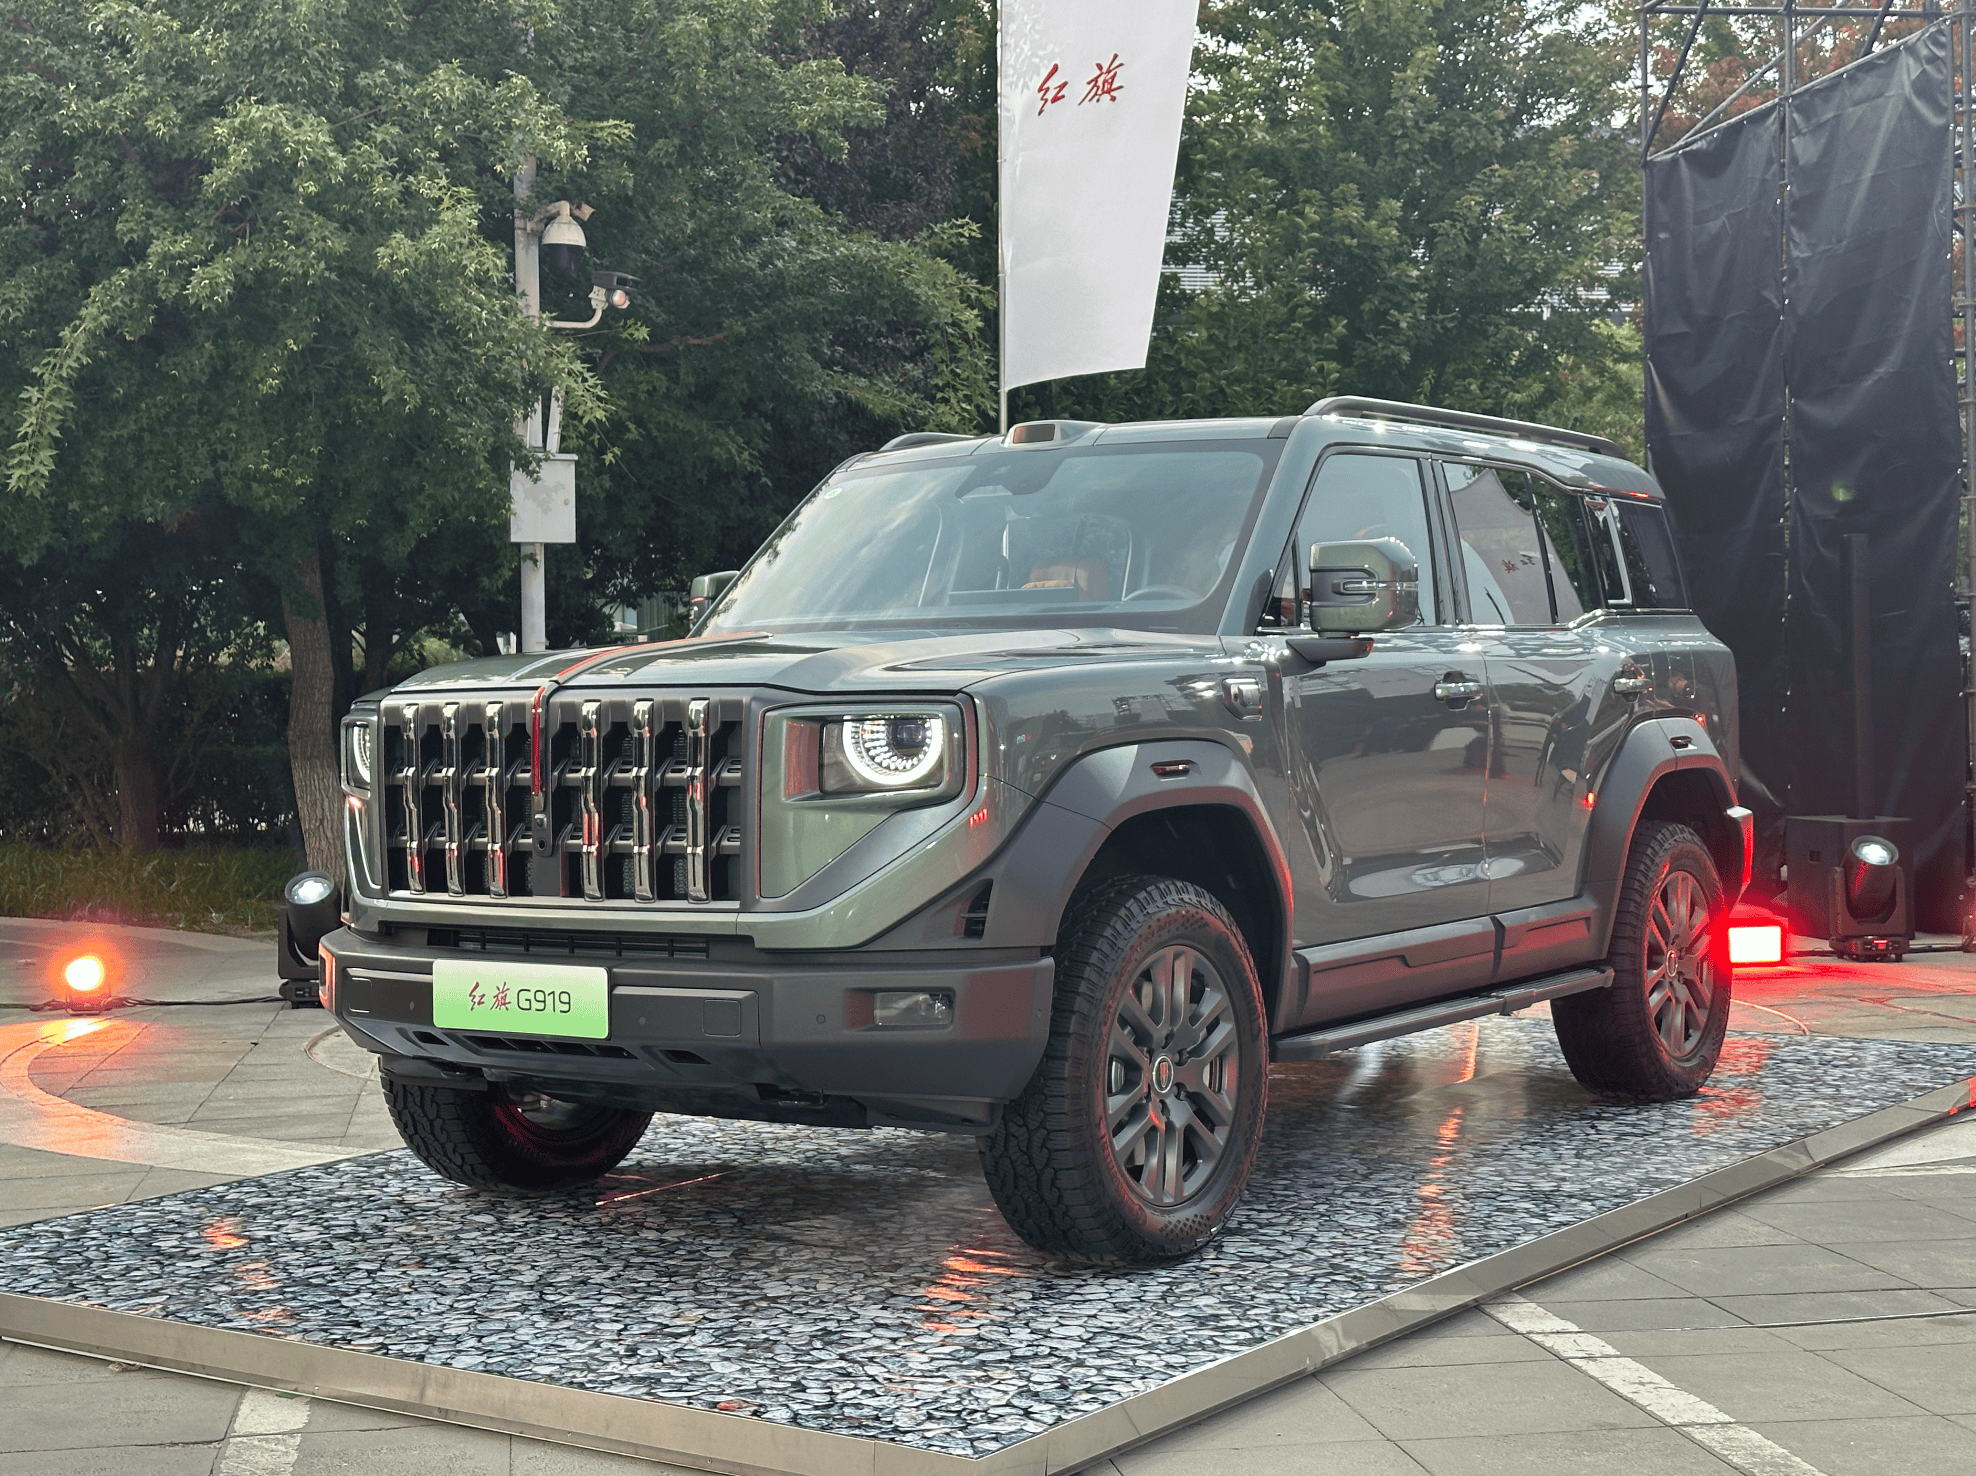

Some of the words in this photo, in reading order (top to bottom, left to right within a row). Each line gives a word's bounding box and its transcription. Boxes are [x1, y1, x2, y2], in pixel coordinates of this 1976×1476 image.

[1037, 53, 1124, 116] 红旗
[469, 981, 511, 1011] 红旗
[516, 988, 571, 1014] G919
